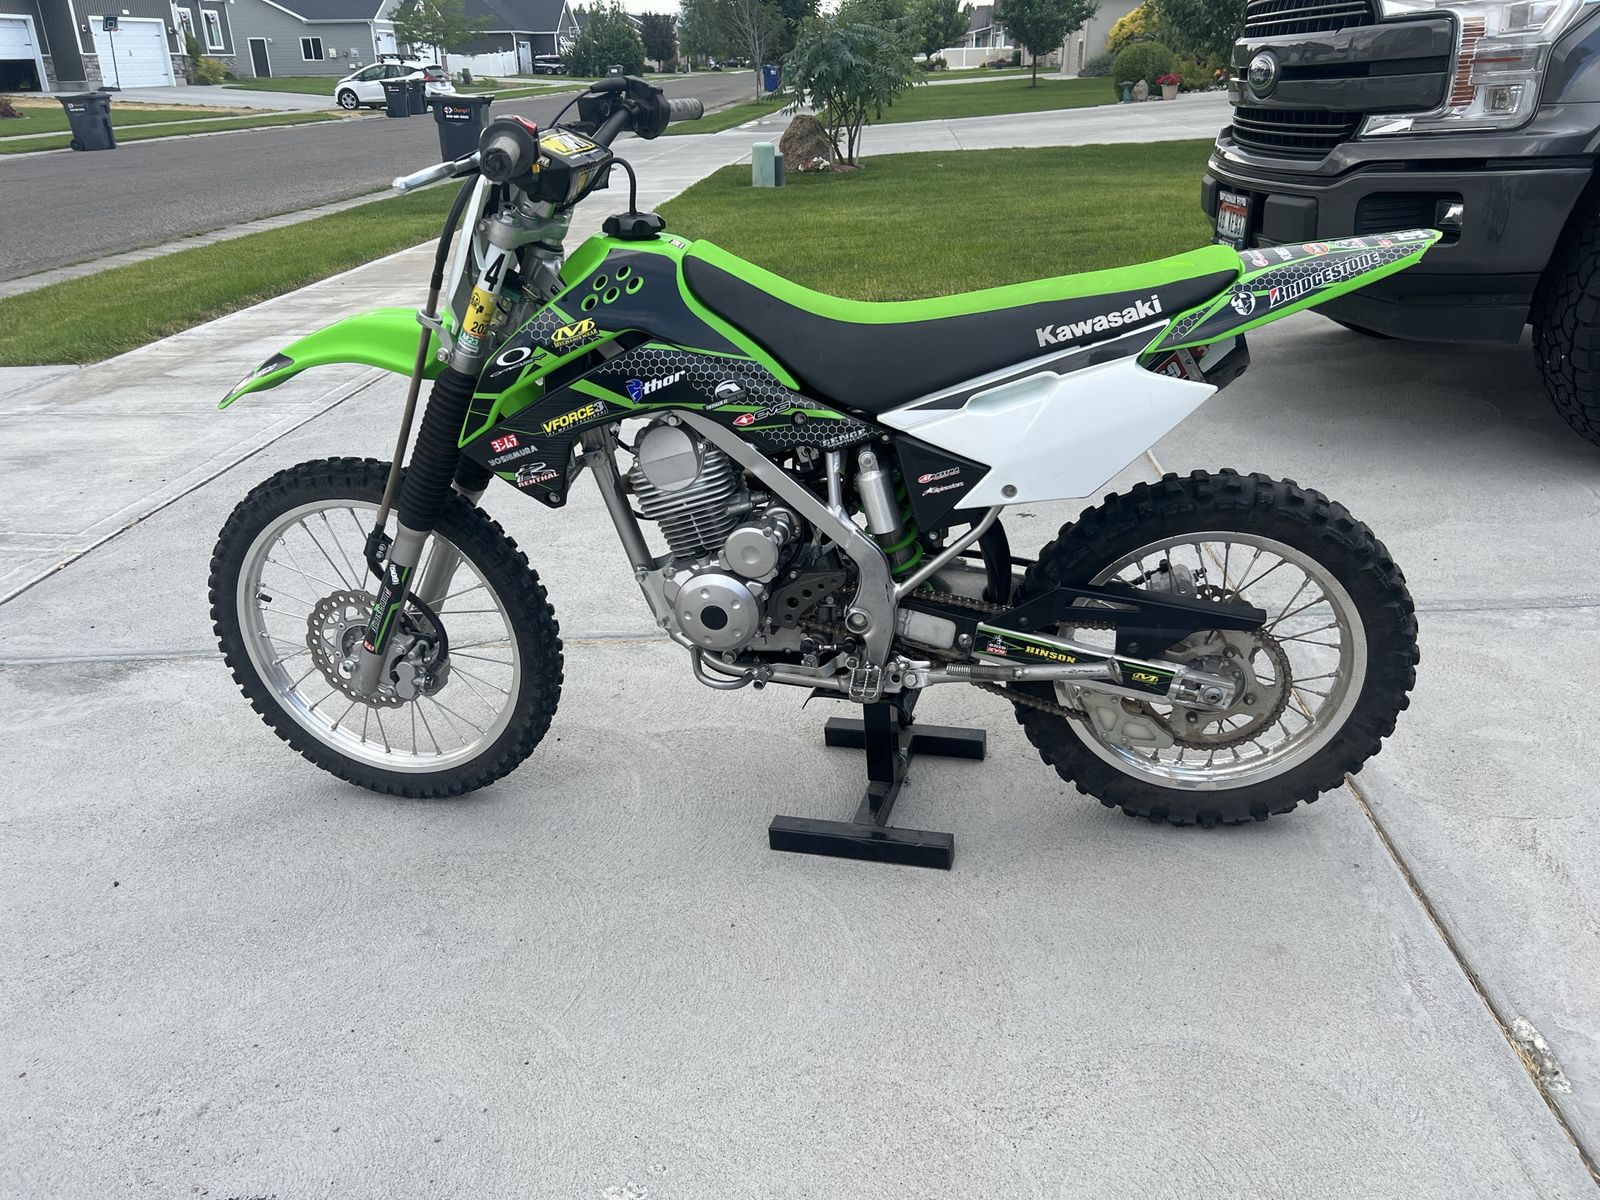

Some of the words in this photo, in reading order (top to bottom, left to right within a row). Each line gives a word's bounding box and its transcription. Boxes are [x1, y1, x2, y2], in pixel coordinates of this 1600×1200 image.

[484, 253, 506, 291] 4
[1268, 251, 1381, 309] BRIDGESTONE
[1035, 294, 1163, 348] Kawasaki
[641, 370, 686, 395] thor
[542, 401, 605, 433] VFORCE3
[753, 401, 792, 421] EVS
[487, 444, 539, 467] YOSHIMURA
[517, 471, 560, 488] RENTHAL
[1025, 645, 1076, 664] HINSON
